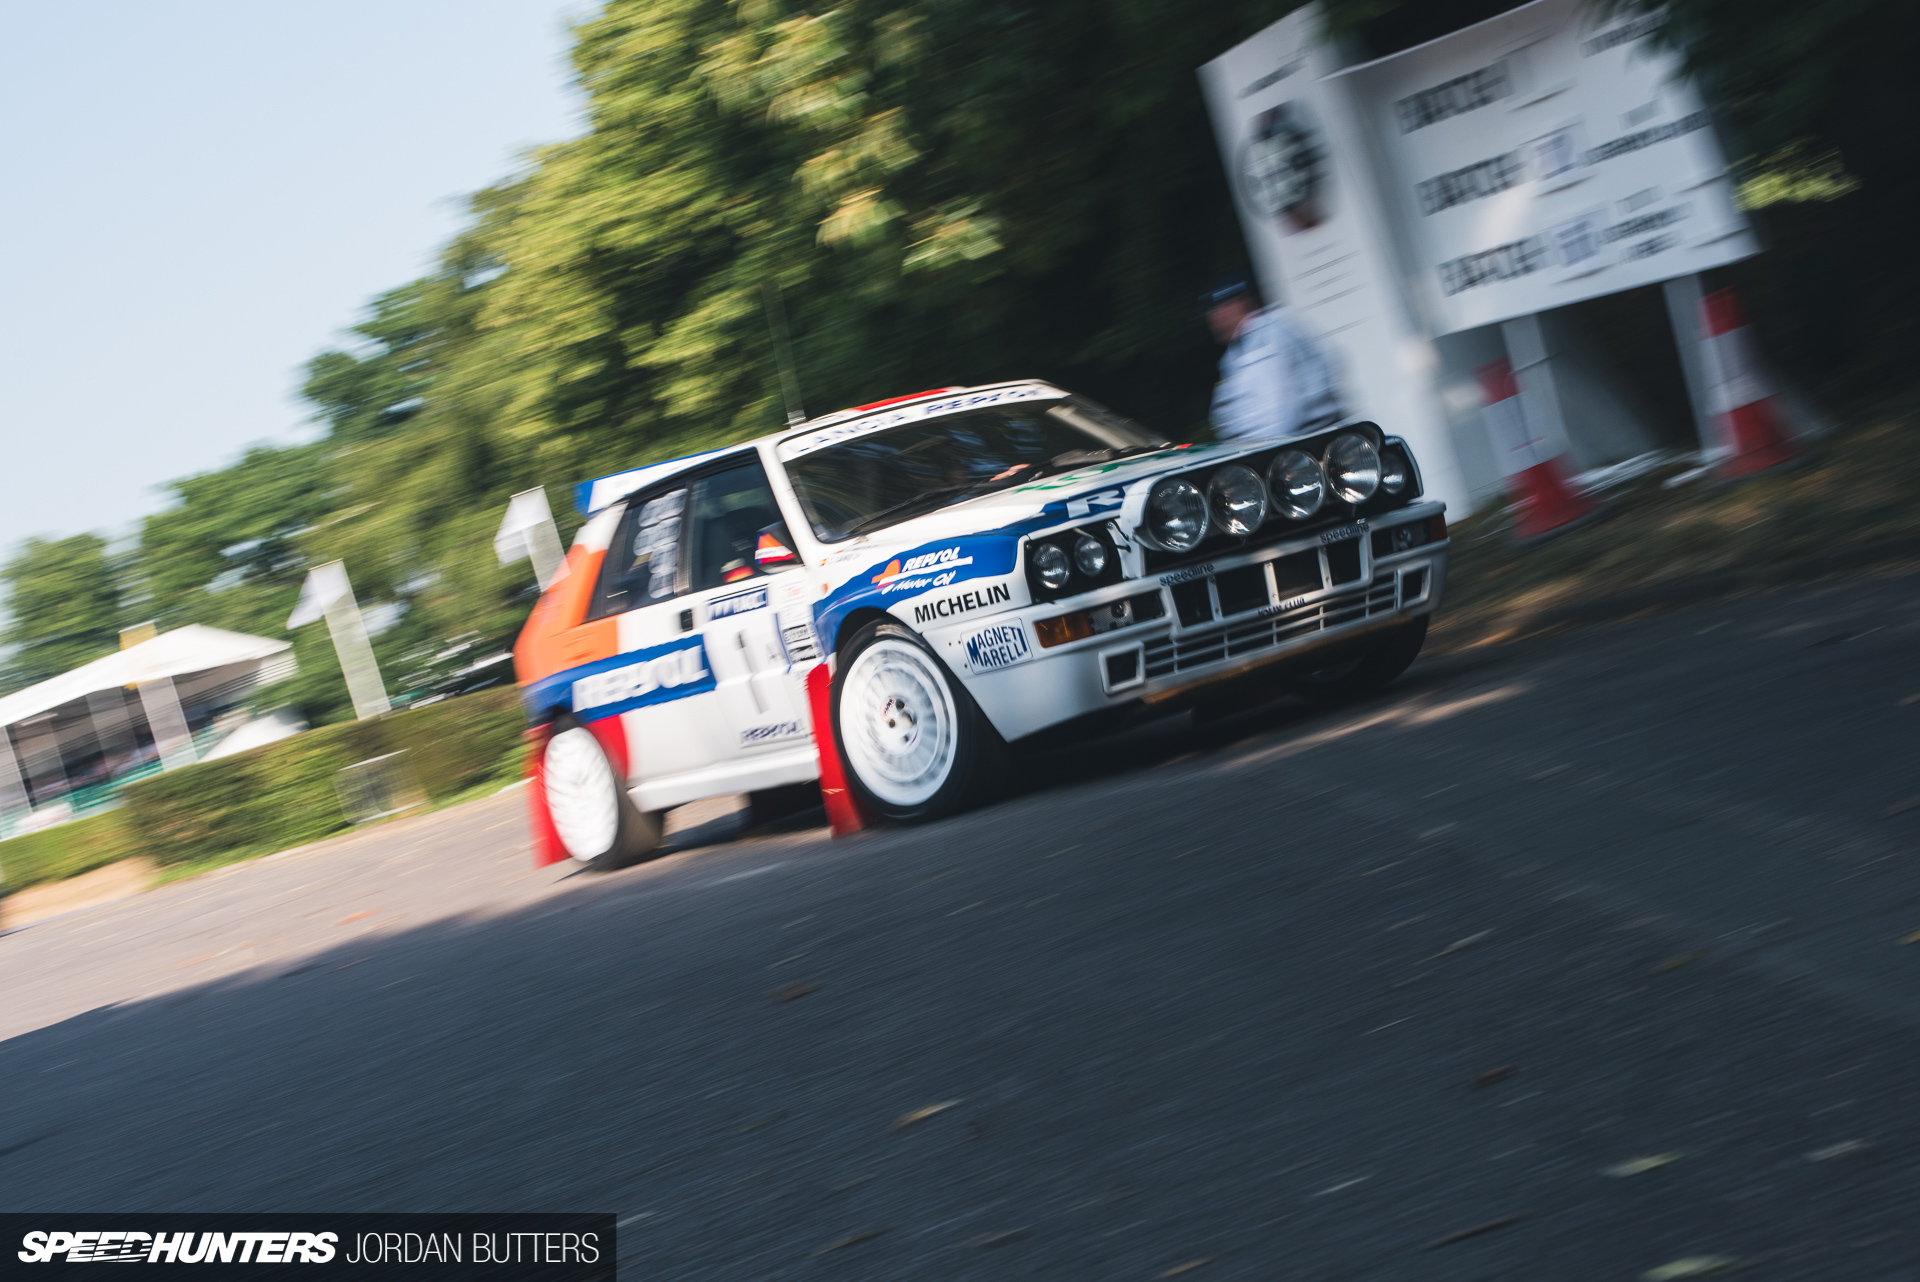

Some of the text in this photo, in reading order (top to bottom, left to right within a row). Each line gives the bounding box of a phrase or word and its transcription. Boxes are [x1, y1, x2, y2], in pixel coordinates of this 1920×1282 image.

[1319, 521, 1370, 544] speedline
[902, 546, 961, 573] REPSOL
[891, 570, 957, 593] Motor Oil
[1159, 562, 1215, 587] speedline
[914, 583, 1011, 624] MICHELIN
[966, 625, 1027, 653] MAGNETI
[967, 643, 1028, 668] MARELLI
[572, 644, 709, 713] REPSOL
